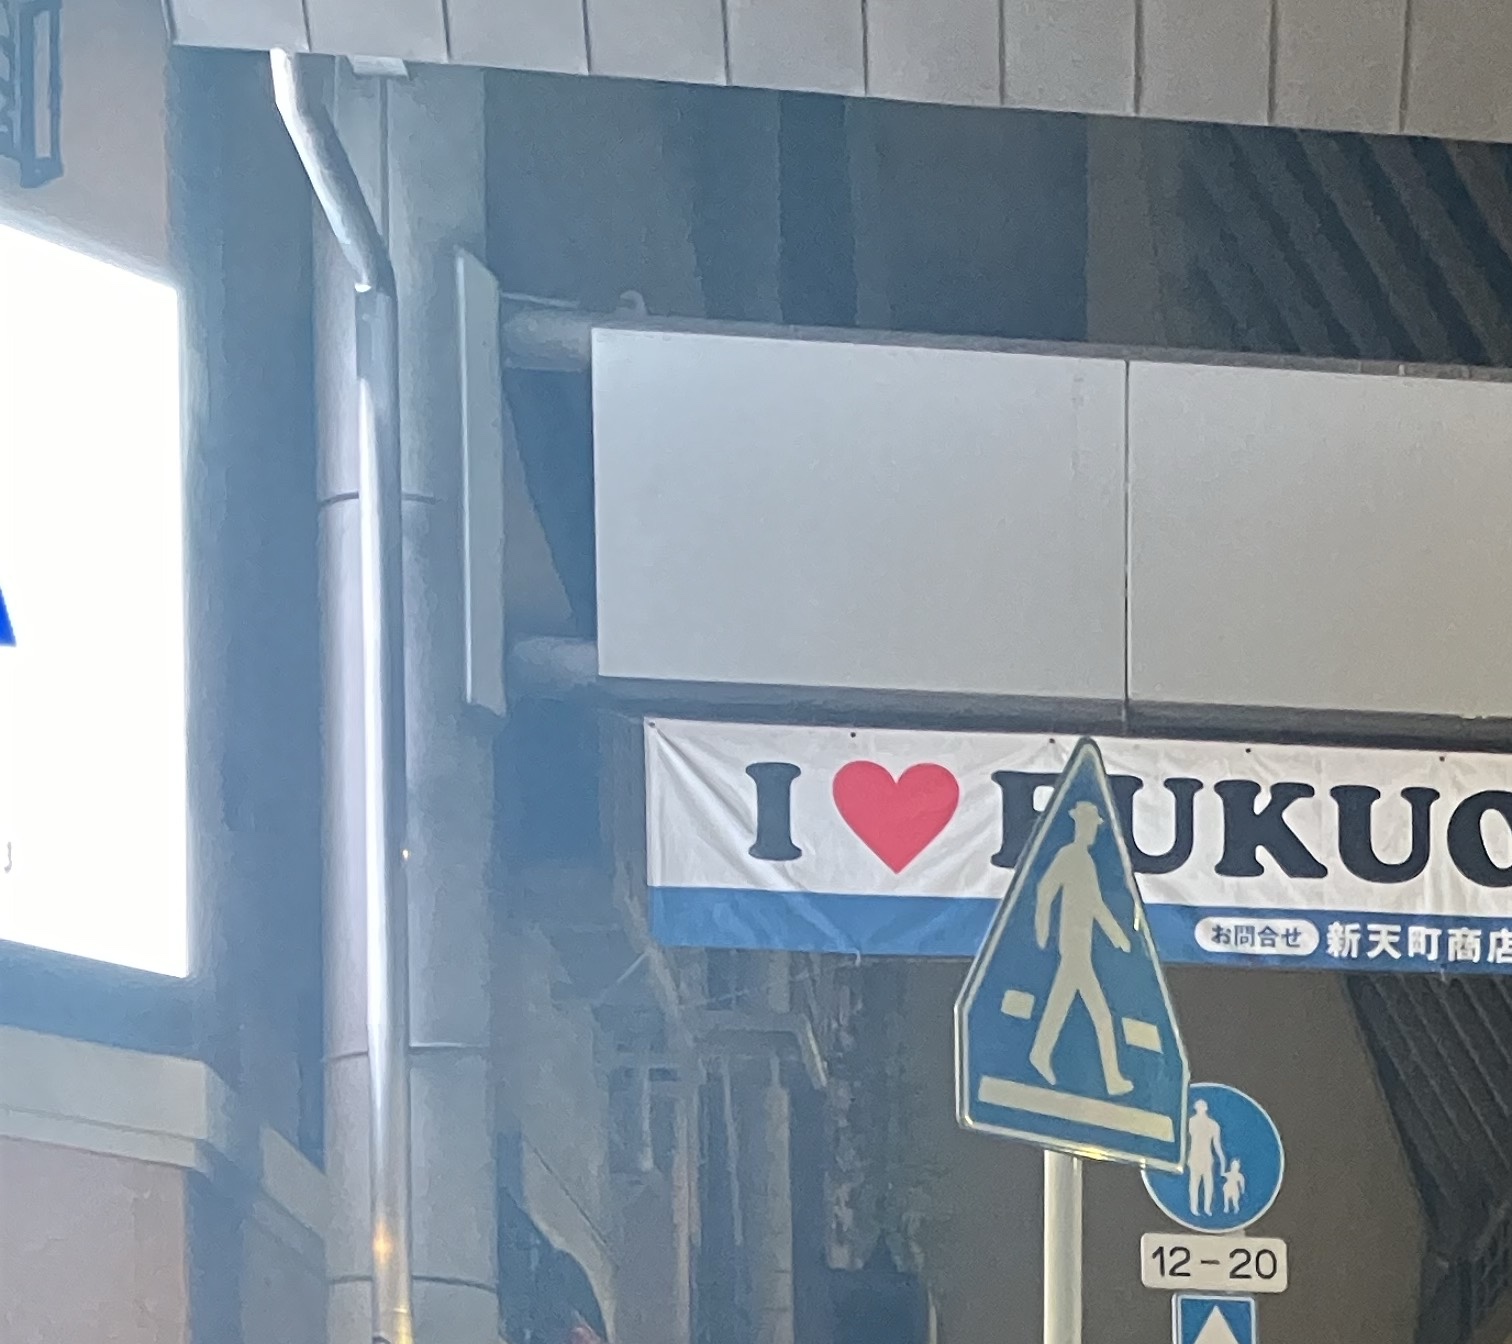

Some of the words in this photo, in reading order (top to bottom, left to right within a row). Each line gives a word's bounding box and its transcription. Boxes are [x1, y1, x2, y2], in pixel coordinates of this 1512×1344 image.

[745, 762, 802, 861] I
[1210, 924, 1302, 949] お問合せ
[1152, 1246, 1278, 1280] 12-20
